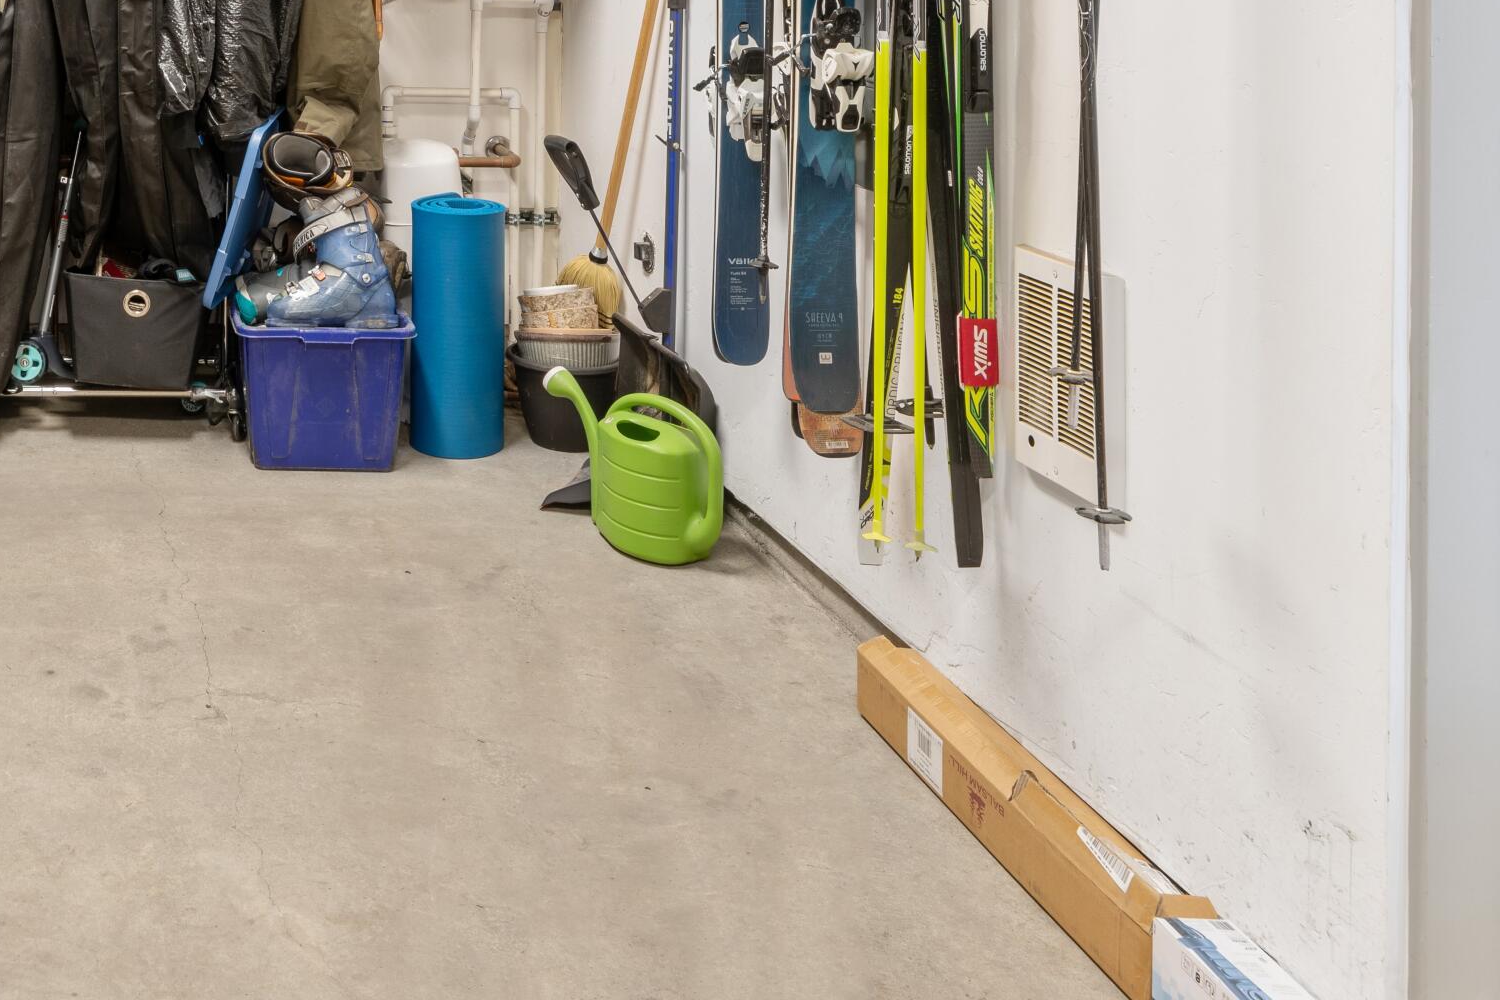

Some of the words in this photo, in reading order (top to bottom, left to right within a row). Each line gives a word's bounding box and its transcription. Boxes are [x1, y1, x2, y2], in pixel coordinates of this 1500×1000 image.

[979, 28, 987, 72] salomon
[967, 178, 984, 257] SKATING
[893, 287, 904, 304] 184
[805, 312, 836, 324] SHEEVA
[949, 754, 969, 780] HILL
[969, 774, 1005, 818] BALSAM
